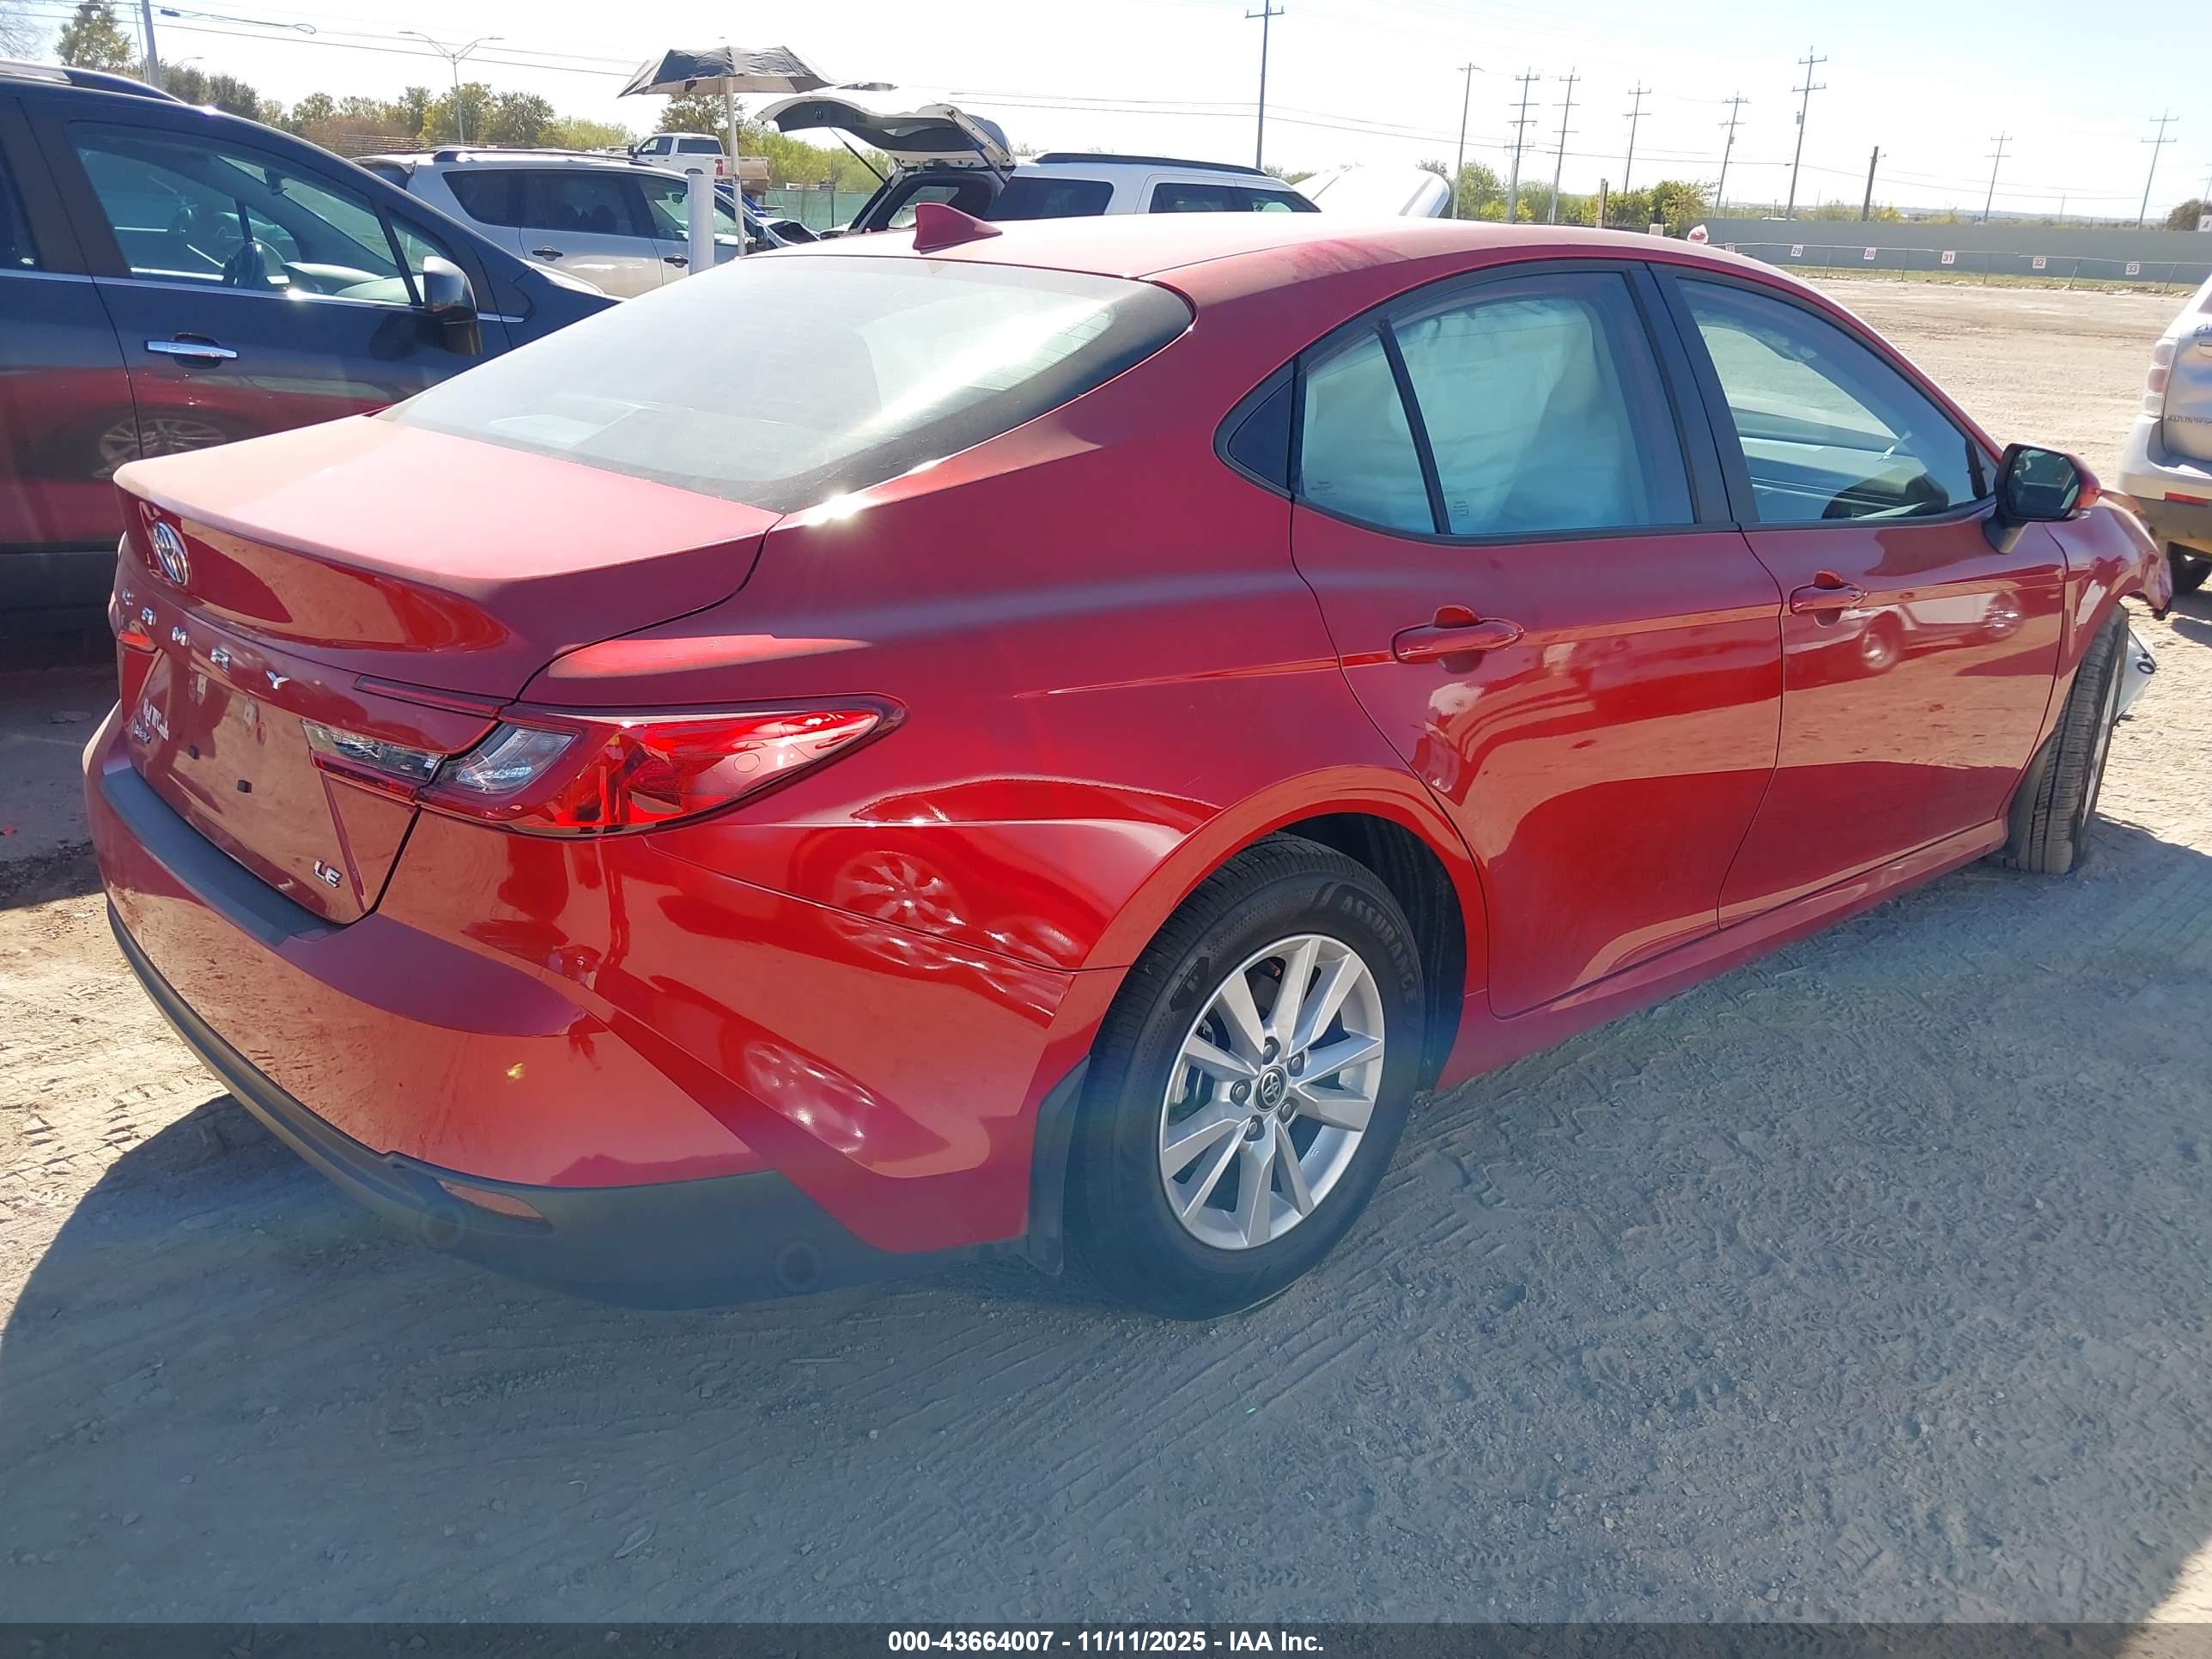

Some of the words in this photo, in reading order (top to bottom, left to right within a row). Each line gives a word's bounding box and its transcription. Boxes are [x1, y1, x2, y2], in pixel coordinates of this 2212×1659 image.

[1943, 253, 1953, 262] 31
[2127, 264, 2137, 273] 33
[122, 589, 290, 690] CAMRY
[313, 860, 343, 889] LE
[1340, 895, 1417, 1003] ASSURANCE
